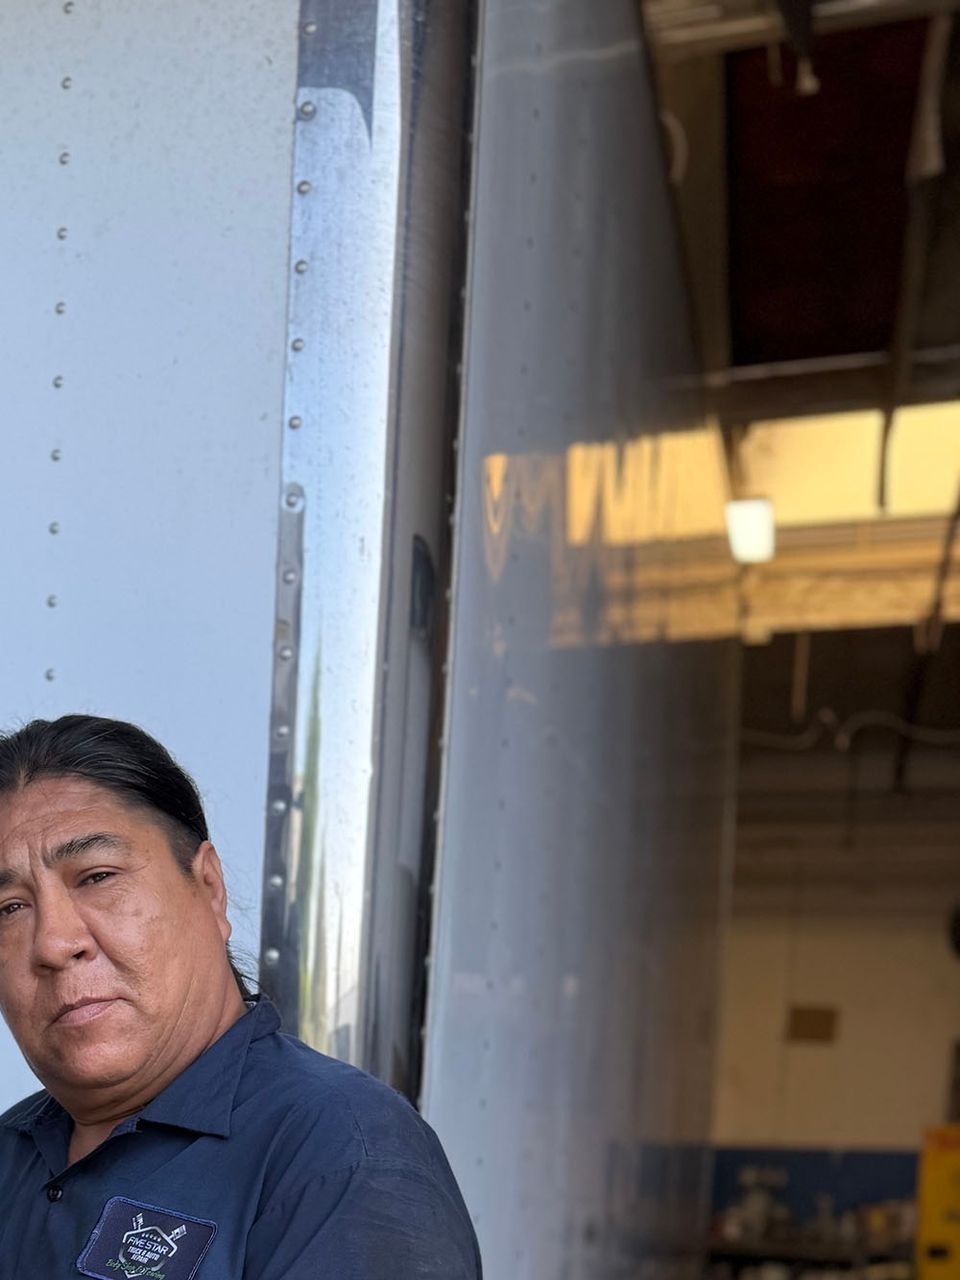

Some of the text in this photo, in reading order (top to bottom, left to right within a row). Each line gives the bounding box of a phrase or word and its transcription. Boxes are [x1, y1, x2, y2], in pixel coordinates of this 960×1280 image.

[127, 1236, 169, 1255] FIVE STAR
[127, 1246, 143, 1255] TRUCK
[145, 1251, 160, 1261] AUTO
[131, 1254, 149, 1264] REPAIR
